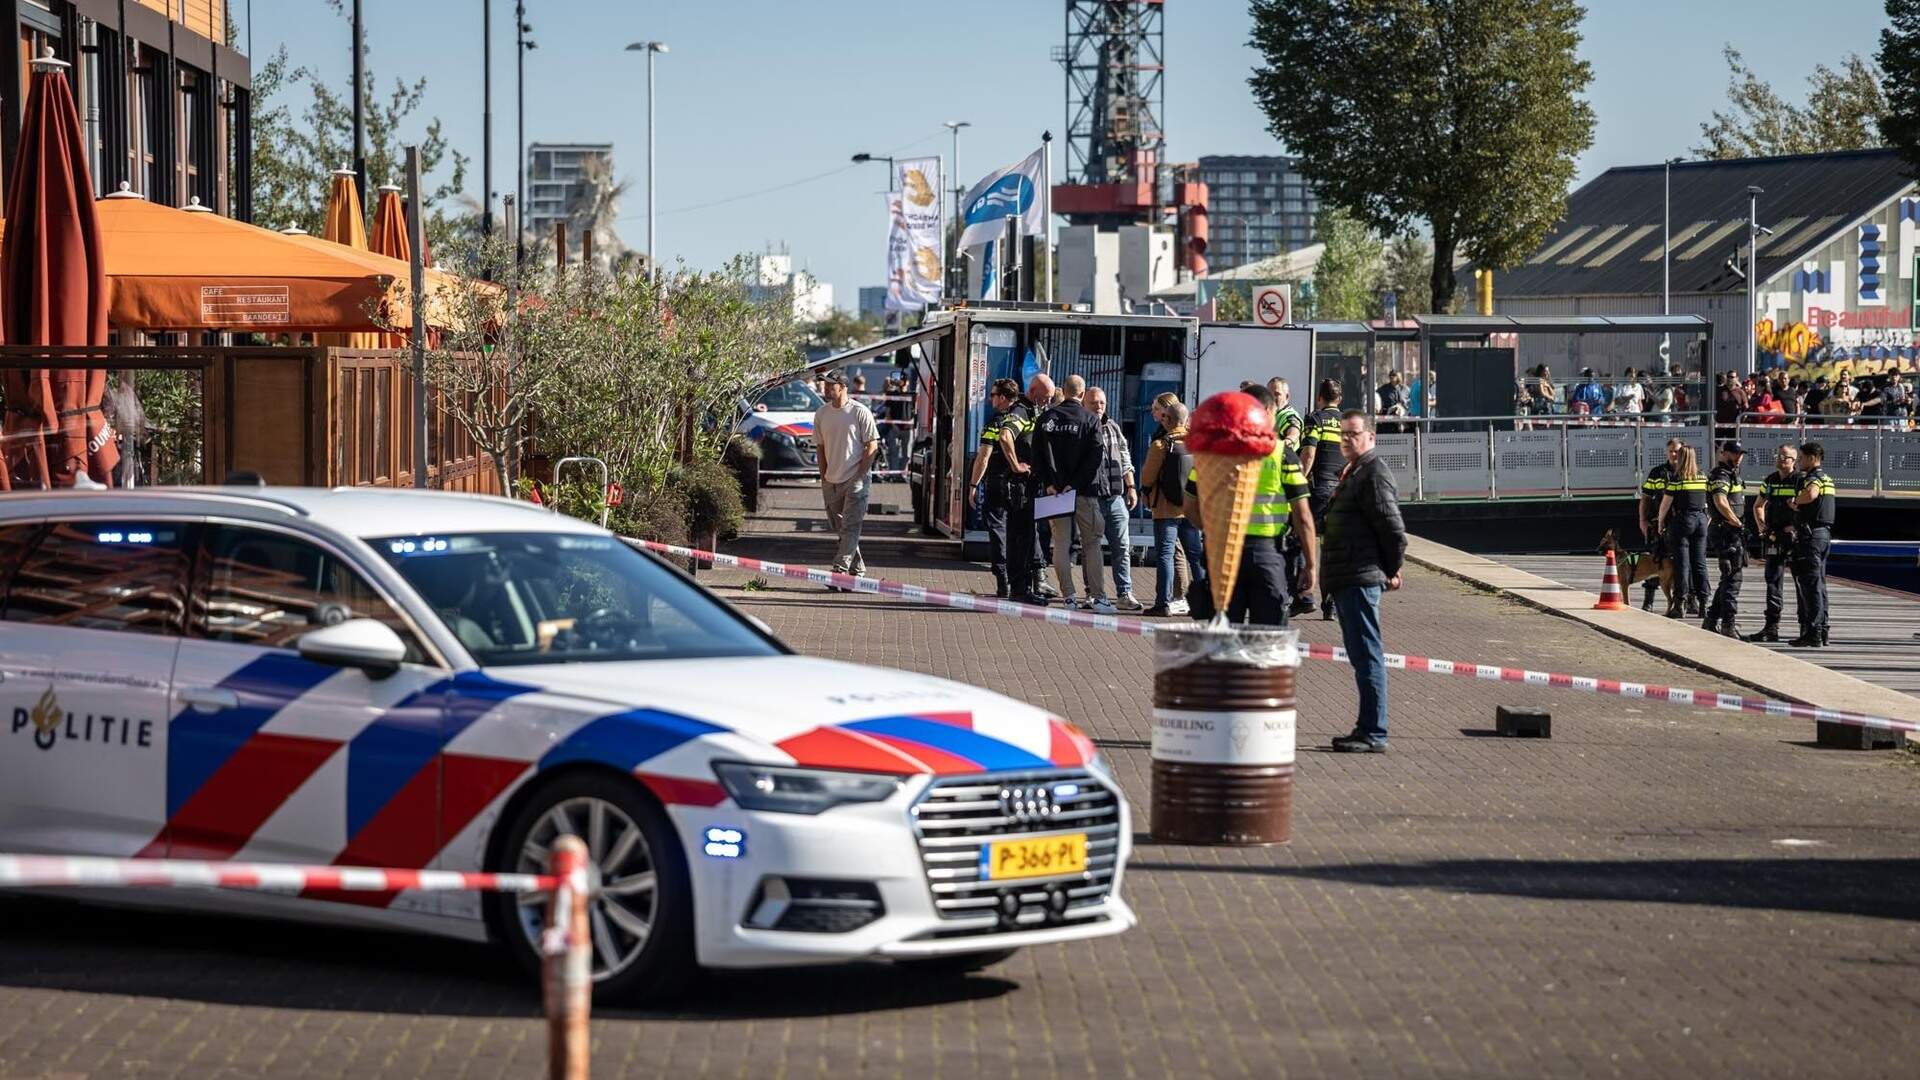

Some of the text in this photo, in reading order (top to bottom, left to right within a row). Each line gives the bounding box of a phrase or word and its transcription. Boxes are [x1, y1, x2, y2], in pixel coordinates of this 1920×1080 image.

[203, 288, 224, 296] CAFE
[236, 296, 287, 304] RESTAURANT
[203, 305, 214, 313] DE
[242, 313, 287, 321] BAANDERIJ
[11, 706, 153, 751] POLITIE
[1000, 843, 1077, 871] P-366-PL
